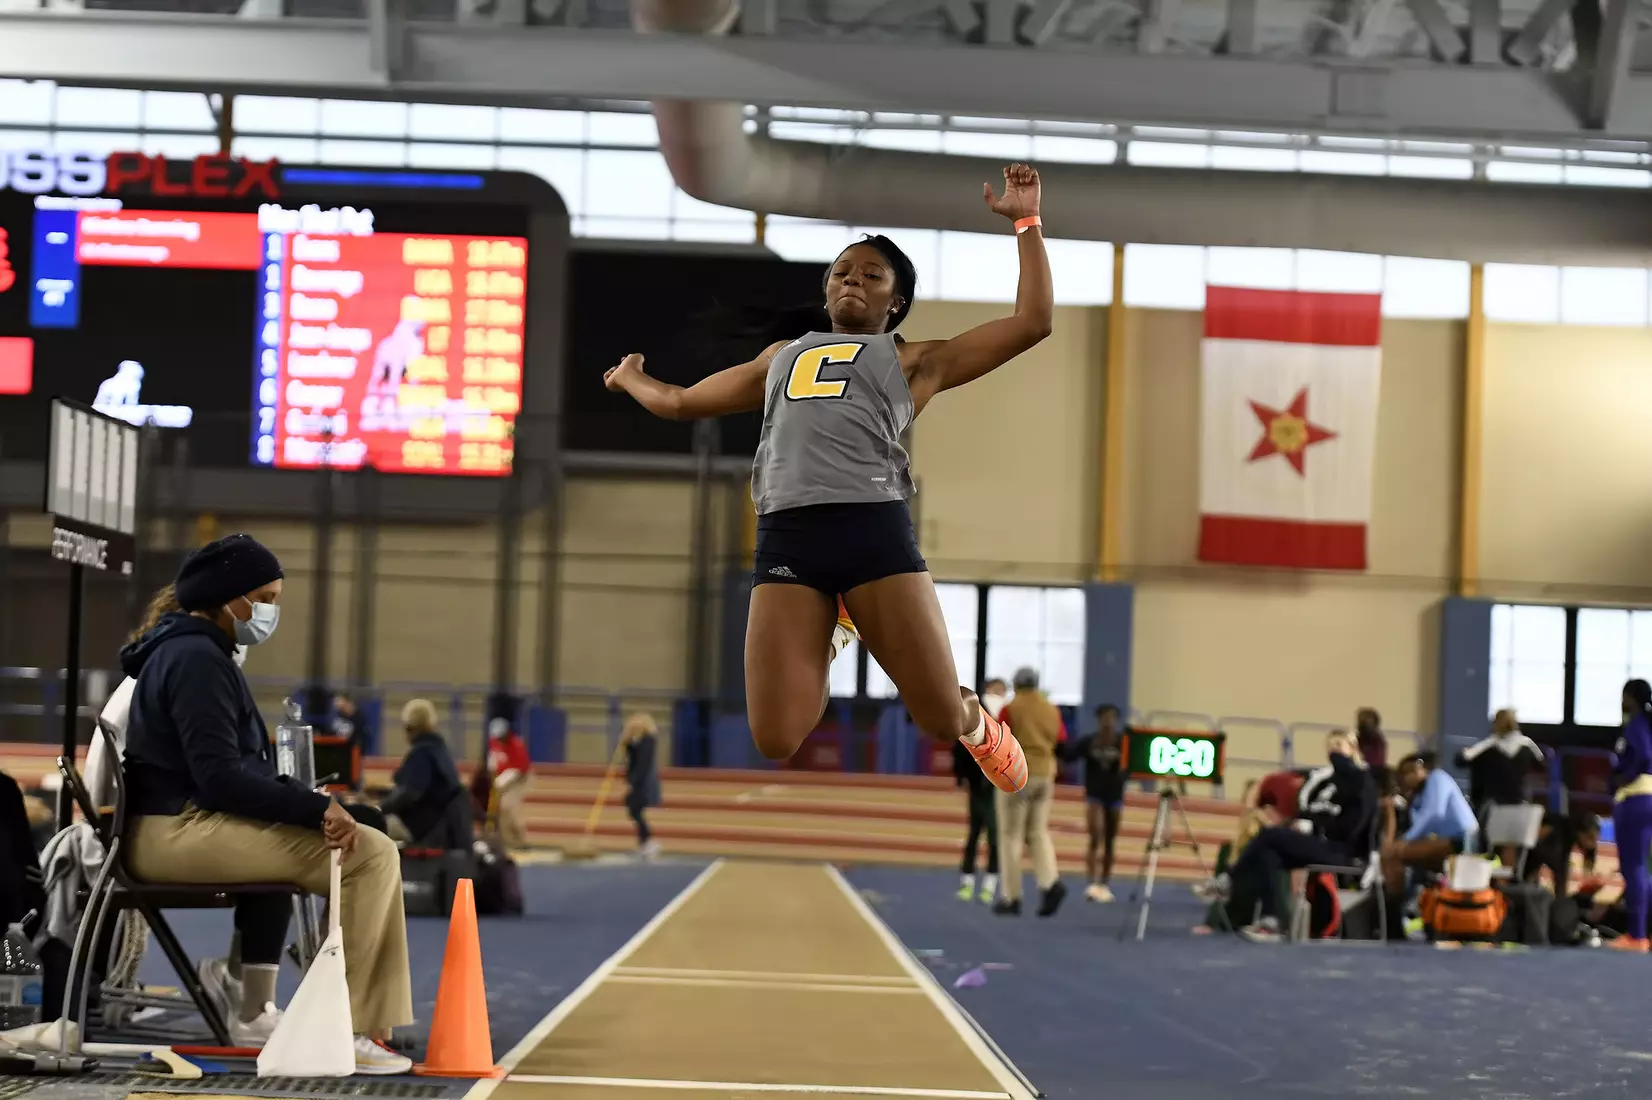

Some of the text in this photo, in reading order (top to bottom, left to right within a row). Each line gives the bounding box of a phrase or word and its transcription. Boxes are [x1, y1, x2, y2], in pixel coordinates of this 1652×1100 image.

[0, 148, 281, 198] SSPLEX
[784, 341, 868, 402] C
[1149, 736, 1215, 778] 0:20
